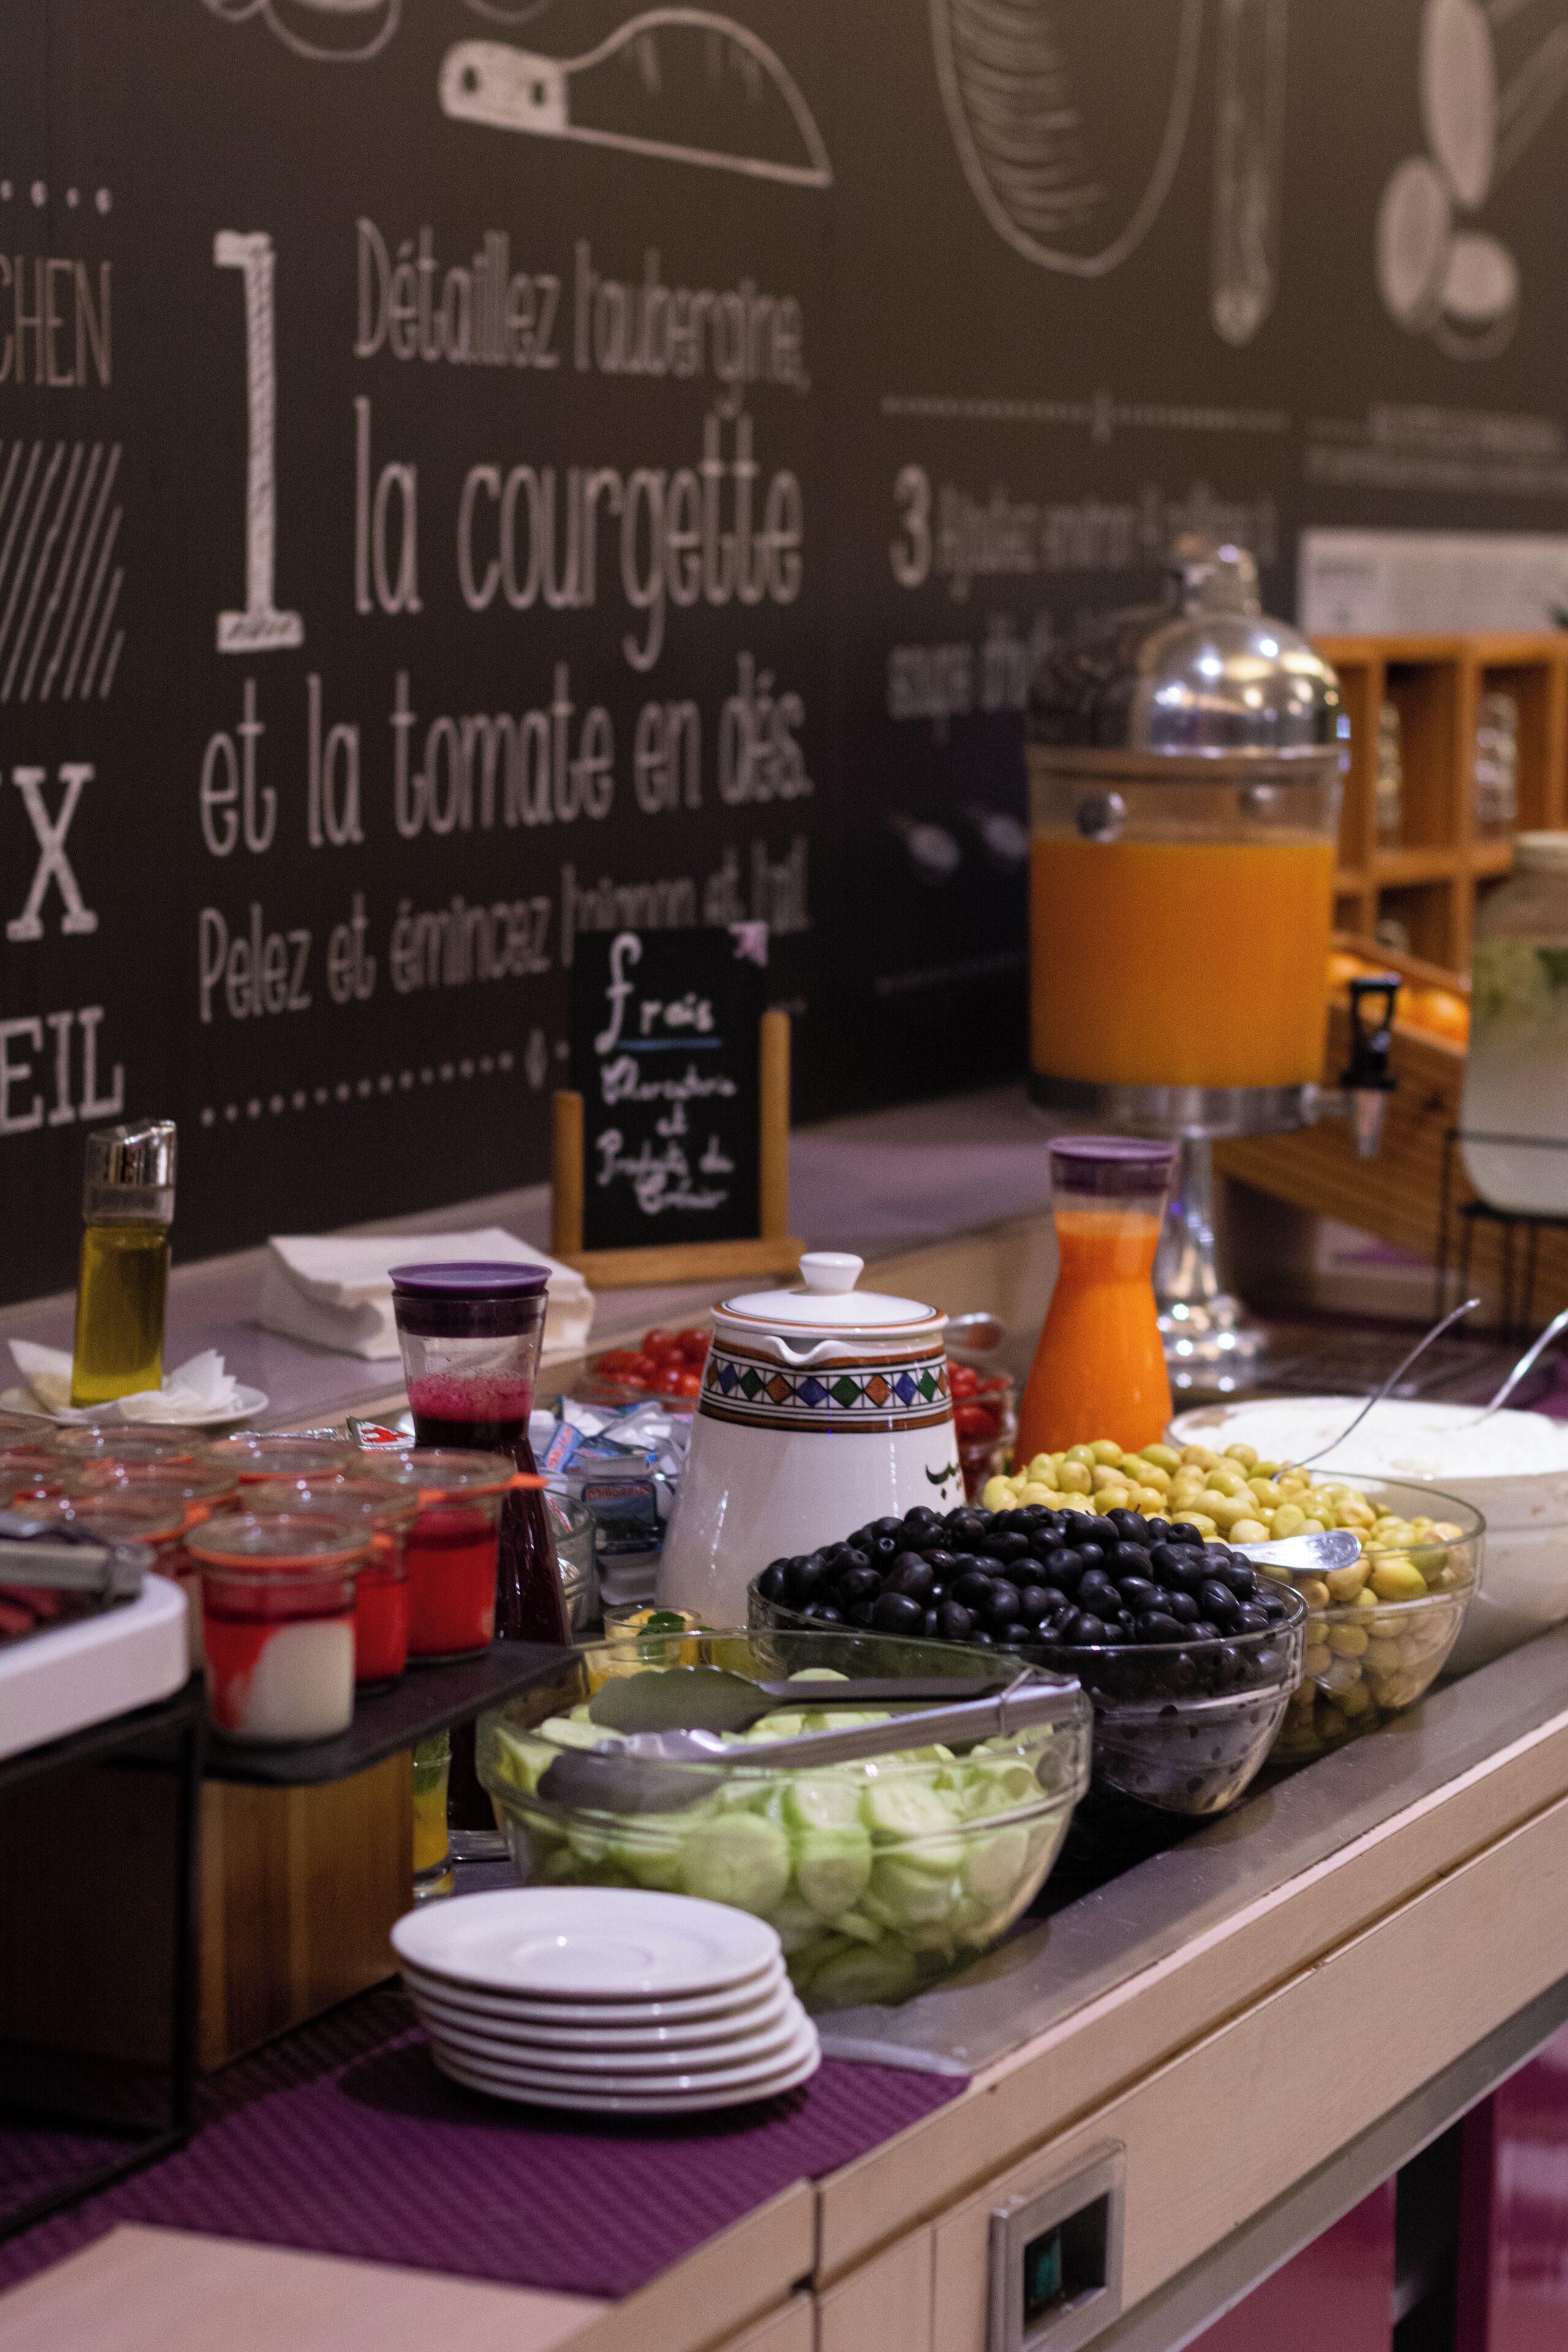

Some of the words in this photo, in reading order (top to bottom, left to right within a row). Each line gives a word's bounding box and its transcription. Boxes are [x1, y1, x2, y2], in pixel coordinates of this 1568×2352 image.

[355, 217, 559, 369] Détaillez
[213, 229, 304, 654] 1
[890, 464, 932, 589] 3
[355, 395, 423, 614] la
[457, 413, 804, 671] courgette
[200, 677, 277, 856] et
[307, 673, 364, 848] la
[390, 664, 613, 837] tomate
[634, 702, 701, 813] en
[198, 903, 313, 1024] Pelez
[327, 891, 378, 1005] et
